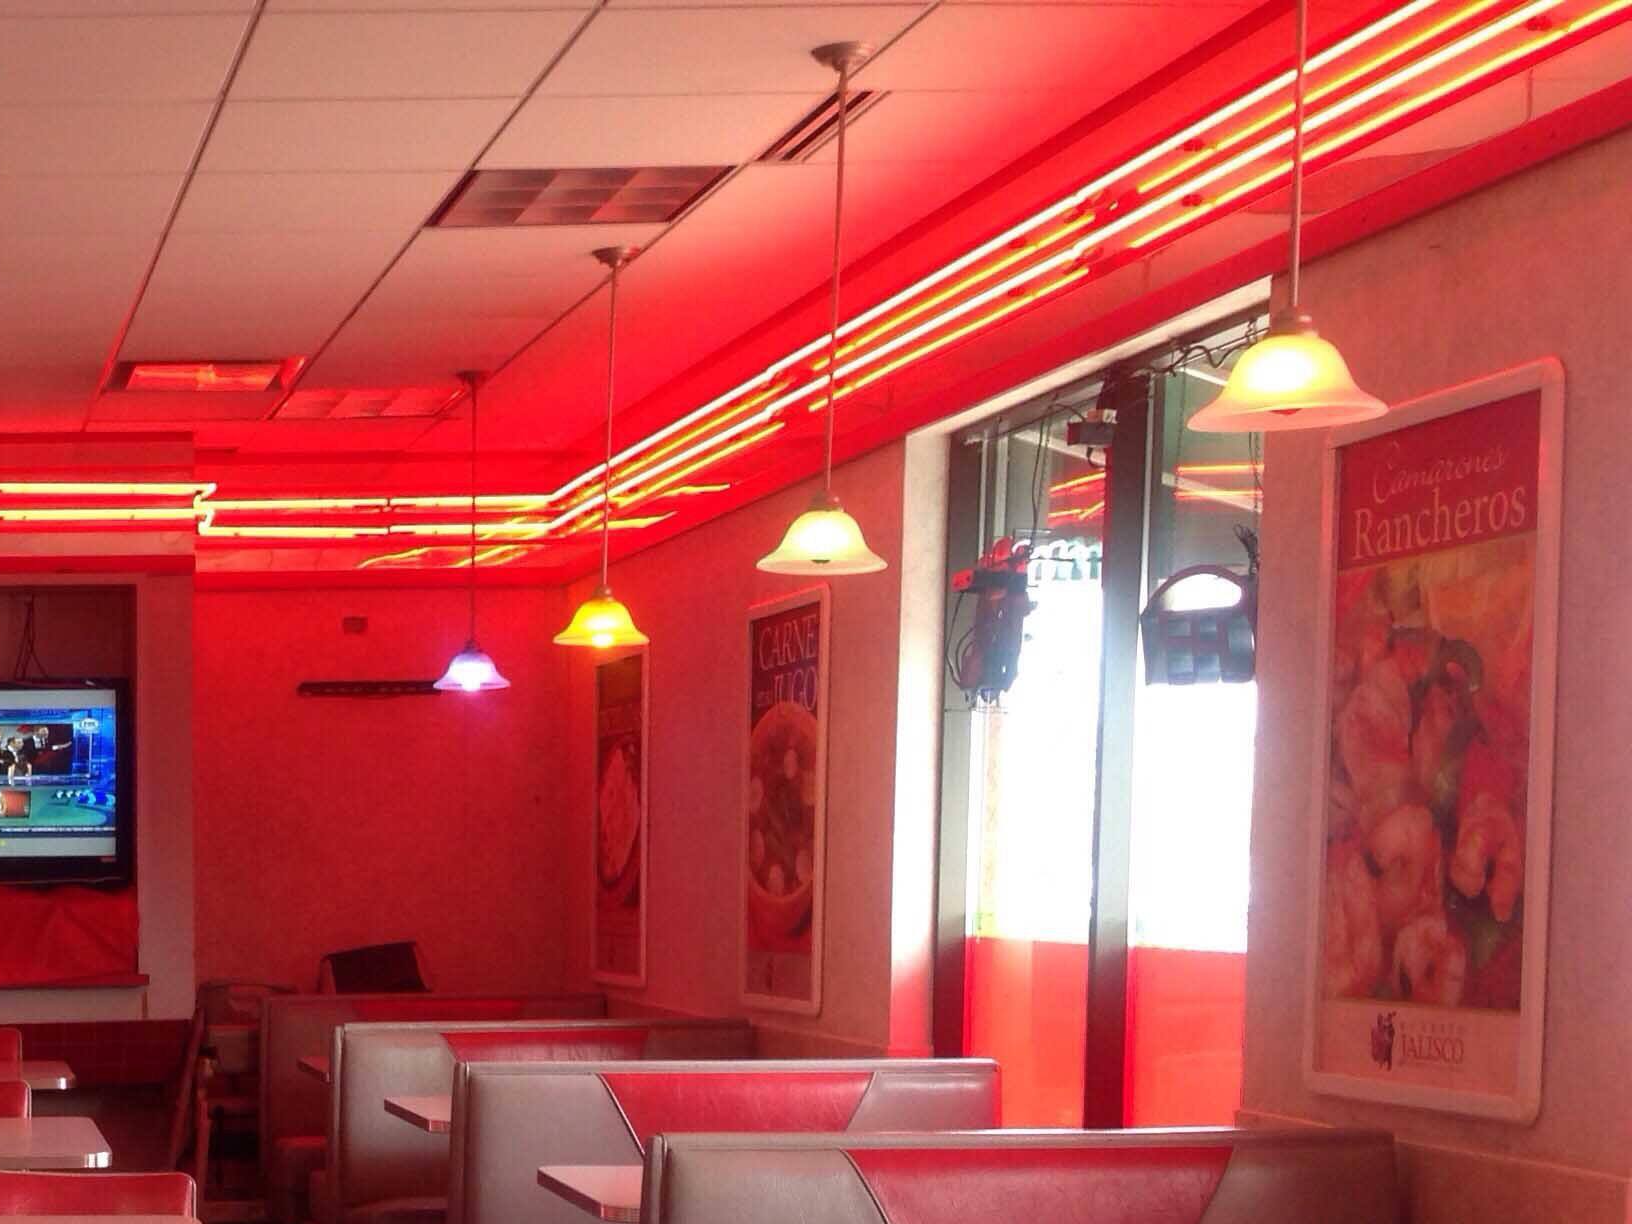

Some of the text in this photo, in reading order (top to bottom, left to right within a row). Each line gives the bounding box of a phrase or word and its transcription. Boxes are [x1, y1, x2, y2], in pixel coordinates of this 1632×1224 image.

[1372, 440, 1506, 504] Camarones
[1352, 485, 1527, 561] Rancheros
[759, 614, 817, 671] CARNE
[1399, 1034, 1465, 1065] JALISCO
